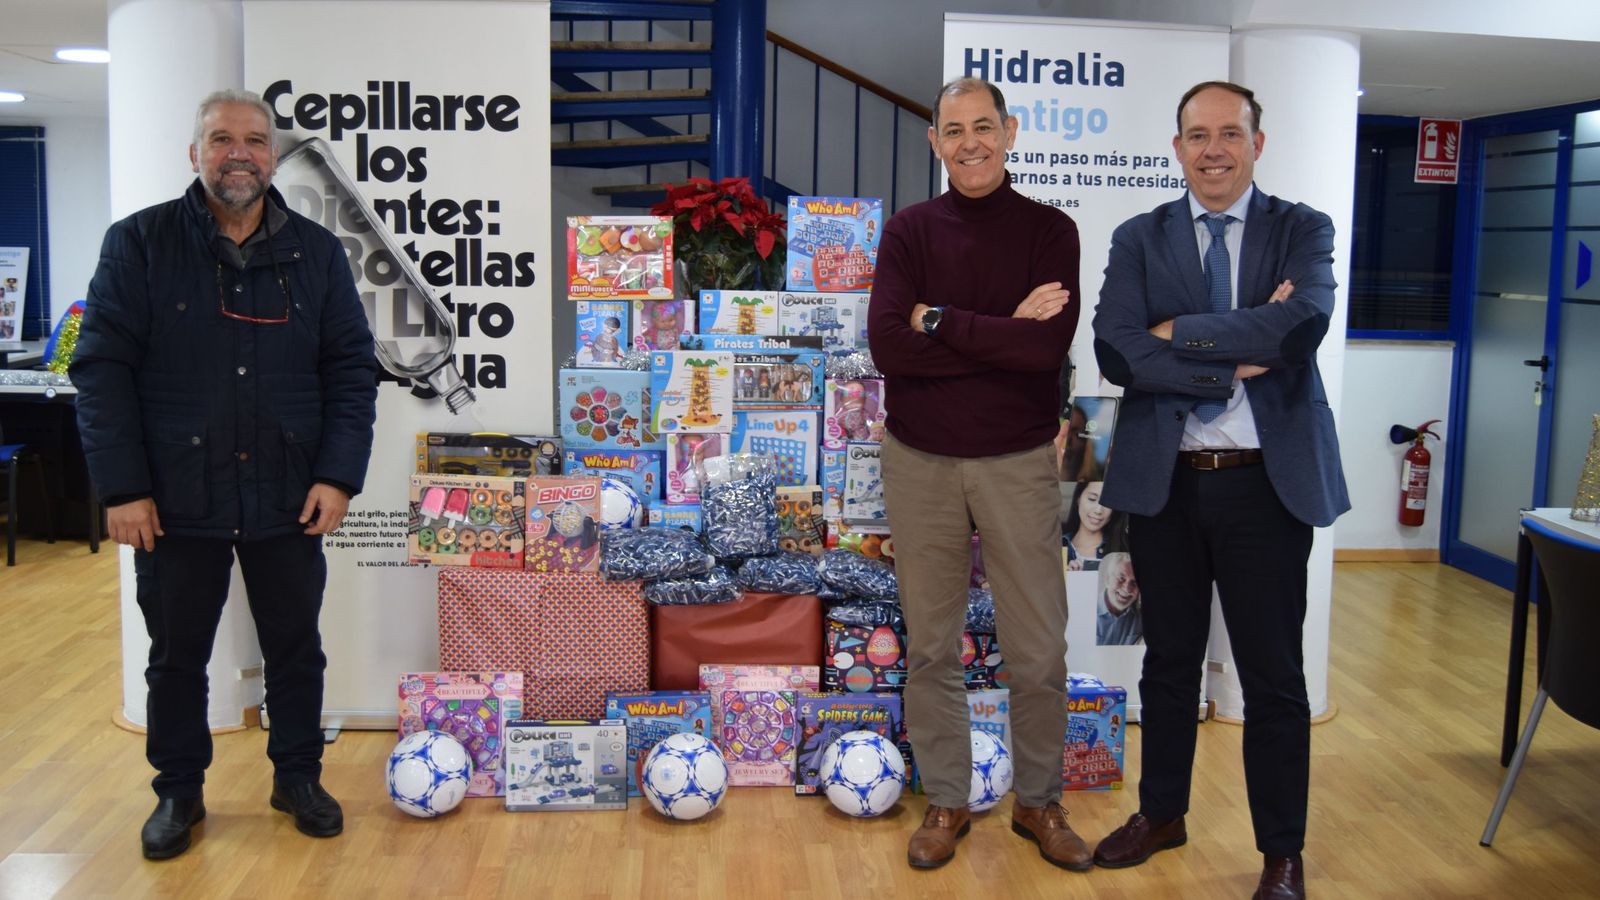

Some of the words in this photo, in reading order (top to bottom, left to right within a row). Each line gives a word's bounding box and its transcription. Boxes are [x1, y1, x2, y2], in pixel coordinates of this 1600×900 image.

[964, 48, 1125, 87] Hidralia
[262, 80, 520, 141] Cepillarse
[356, 133, 428, 182] los
[1025, 152, 1044, 163] un
[1050, 154, 1088, 167] paso
[1094, 151, 1127, 166] más
[1133, 156, 1169, 169] para
[1062, 174, 1071, 185] a
[1077, 172, 1102, 186] tus
[1418, 168, 1455, 177] EXTINTOR
[805, 202, 833, 215] Who
[834, 202, 851, 215] Am
[858, 297, 869, 305] 40
[714, 338, 754, 349] Pirates
[758, 338, 791, 349] Tribal
[583, 455, 610, 468] Who
[611, 455, 628, 468] Am
[539, 484, 596, 503] BINGO
[367, 510, 388, 519] grifo,
[627, 701, 657, 716] Who
[658, 701, 677, 715] Am
[1077, 697, 1096, 712] Am
[817, 709, 858, 721] SPIDERS
[861, 709, 889, 721] GAME
[597, 730, 609, 738] 40
